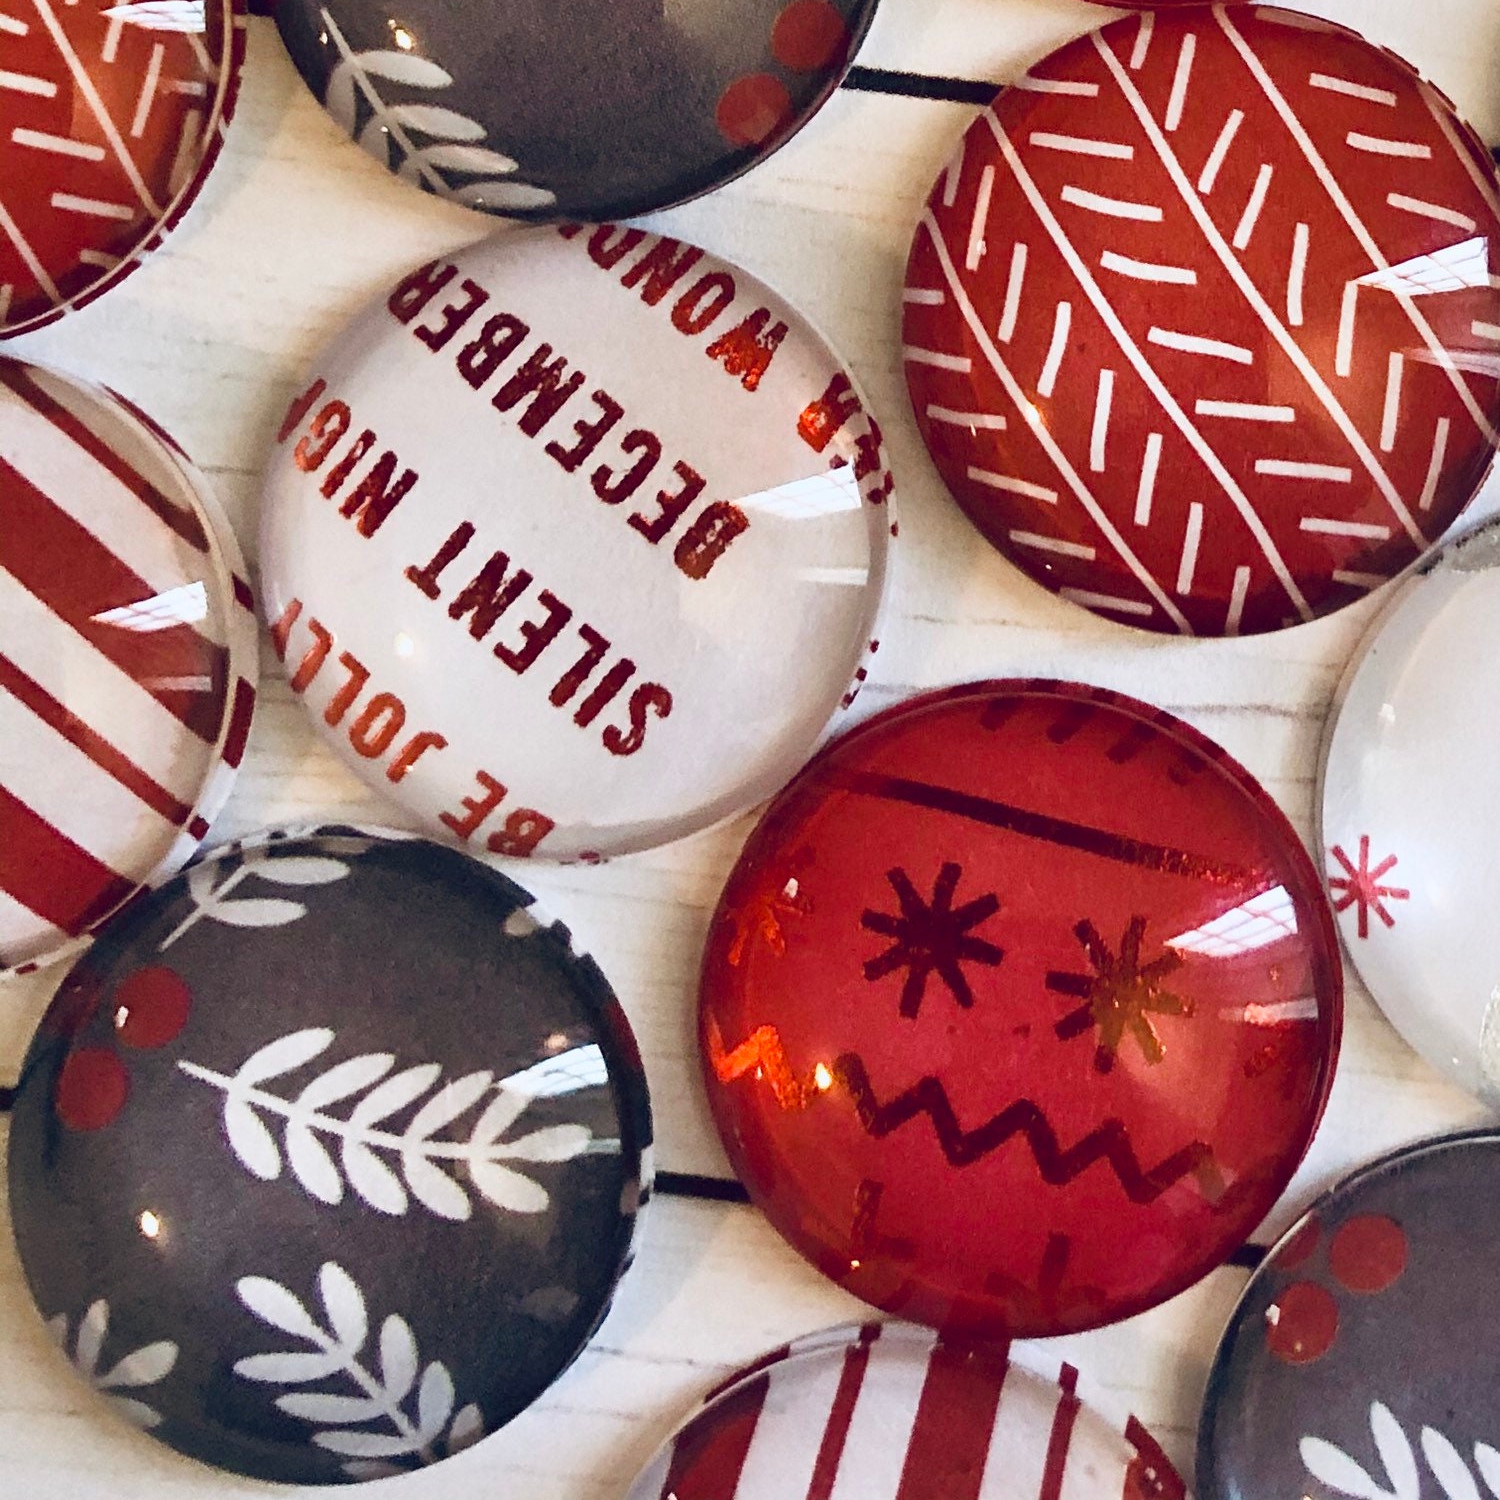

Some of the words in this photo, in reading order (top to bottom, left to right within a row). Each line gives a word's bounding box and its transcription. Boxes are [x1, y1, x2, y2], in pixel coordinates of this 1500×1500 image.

[387, 259, 750, 581] DECEMBER
[270, 598, 449, 784] JOLLY
[404, 520, 674, 757] SILENT
[440, 771, 556, 858] BE
